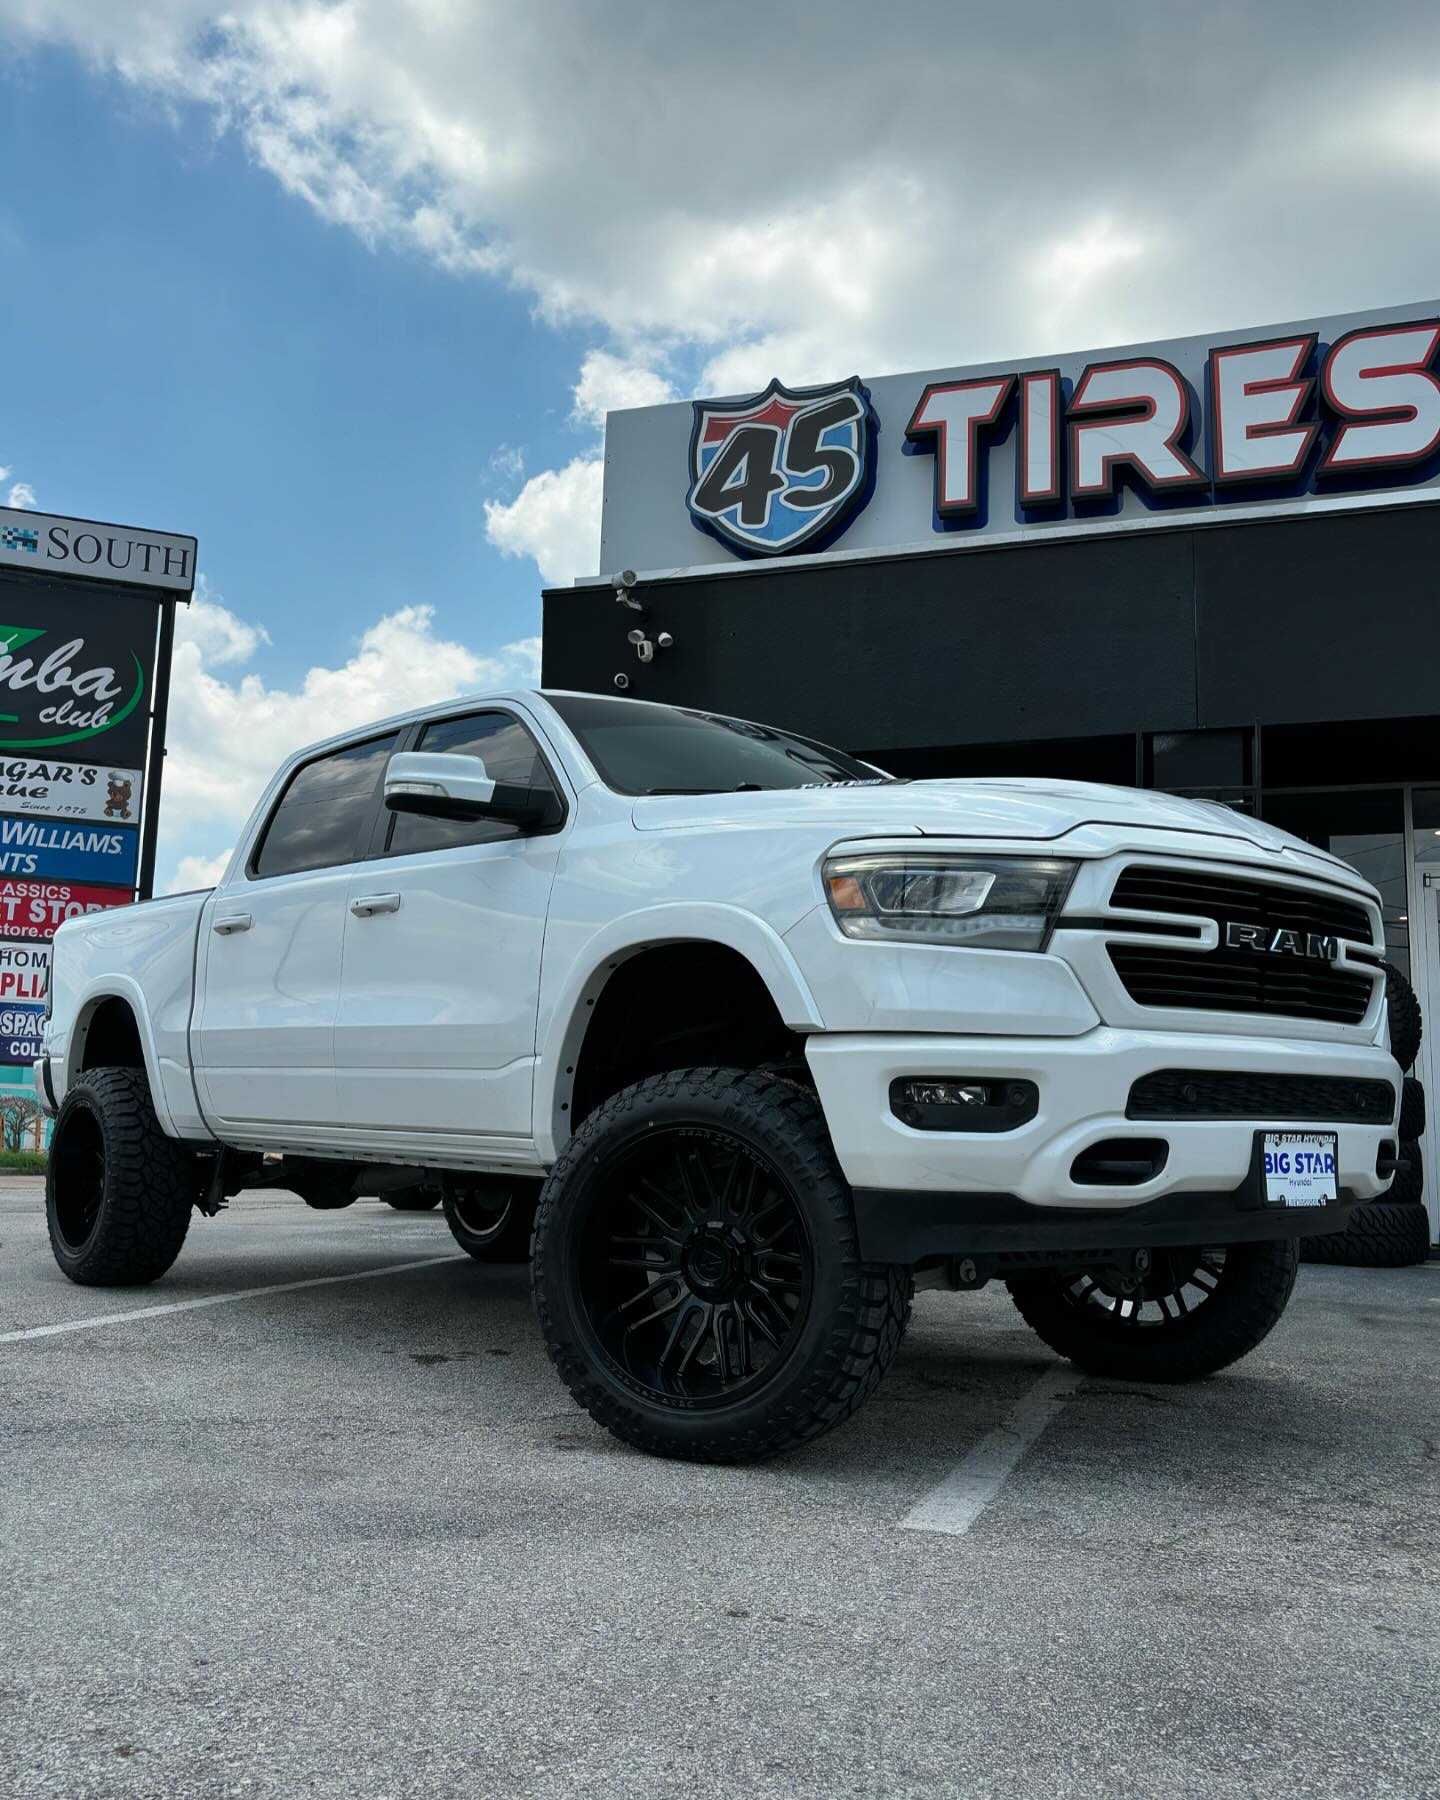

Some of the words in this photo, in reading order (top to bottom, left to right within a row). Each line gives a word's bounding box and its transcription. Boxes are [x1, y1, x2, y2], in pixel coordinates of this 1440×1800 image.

[692, 397, 864, 527] 45
[905, 318, 1440, 517] TIRES
[47, 527, 191, 578] SOUTH
[39, 699, 111, 728] club
[0, 761, 98, 786] GAR'S
[0, 784, 49, 799] ue
[20, 801, 51, 811] Since
[56, 805, 87, 815] 1975
[2, 820, 124, 854] WILLIAMS
[0, 882, 71, 900] ASSICS
[1226, 921, 1338, 961] RAM
[1265, 1134, 1280, 1144] BIG
[1281, 1134, 1303, 1144] STAR
[1303, 1135, 1336, 1144] HYUNDAI
[1264, 1152, 1291, 1174] BIG
[1295, 1152, 1335, 1174] STAR
[1288, 1177, 1312, 1188] Hyundai
